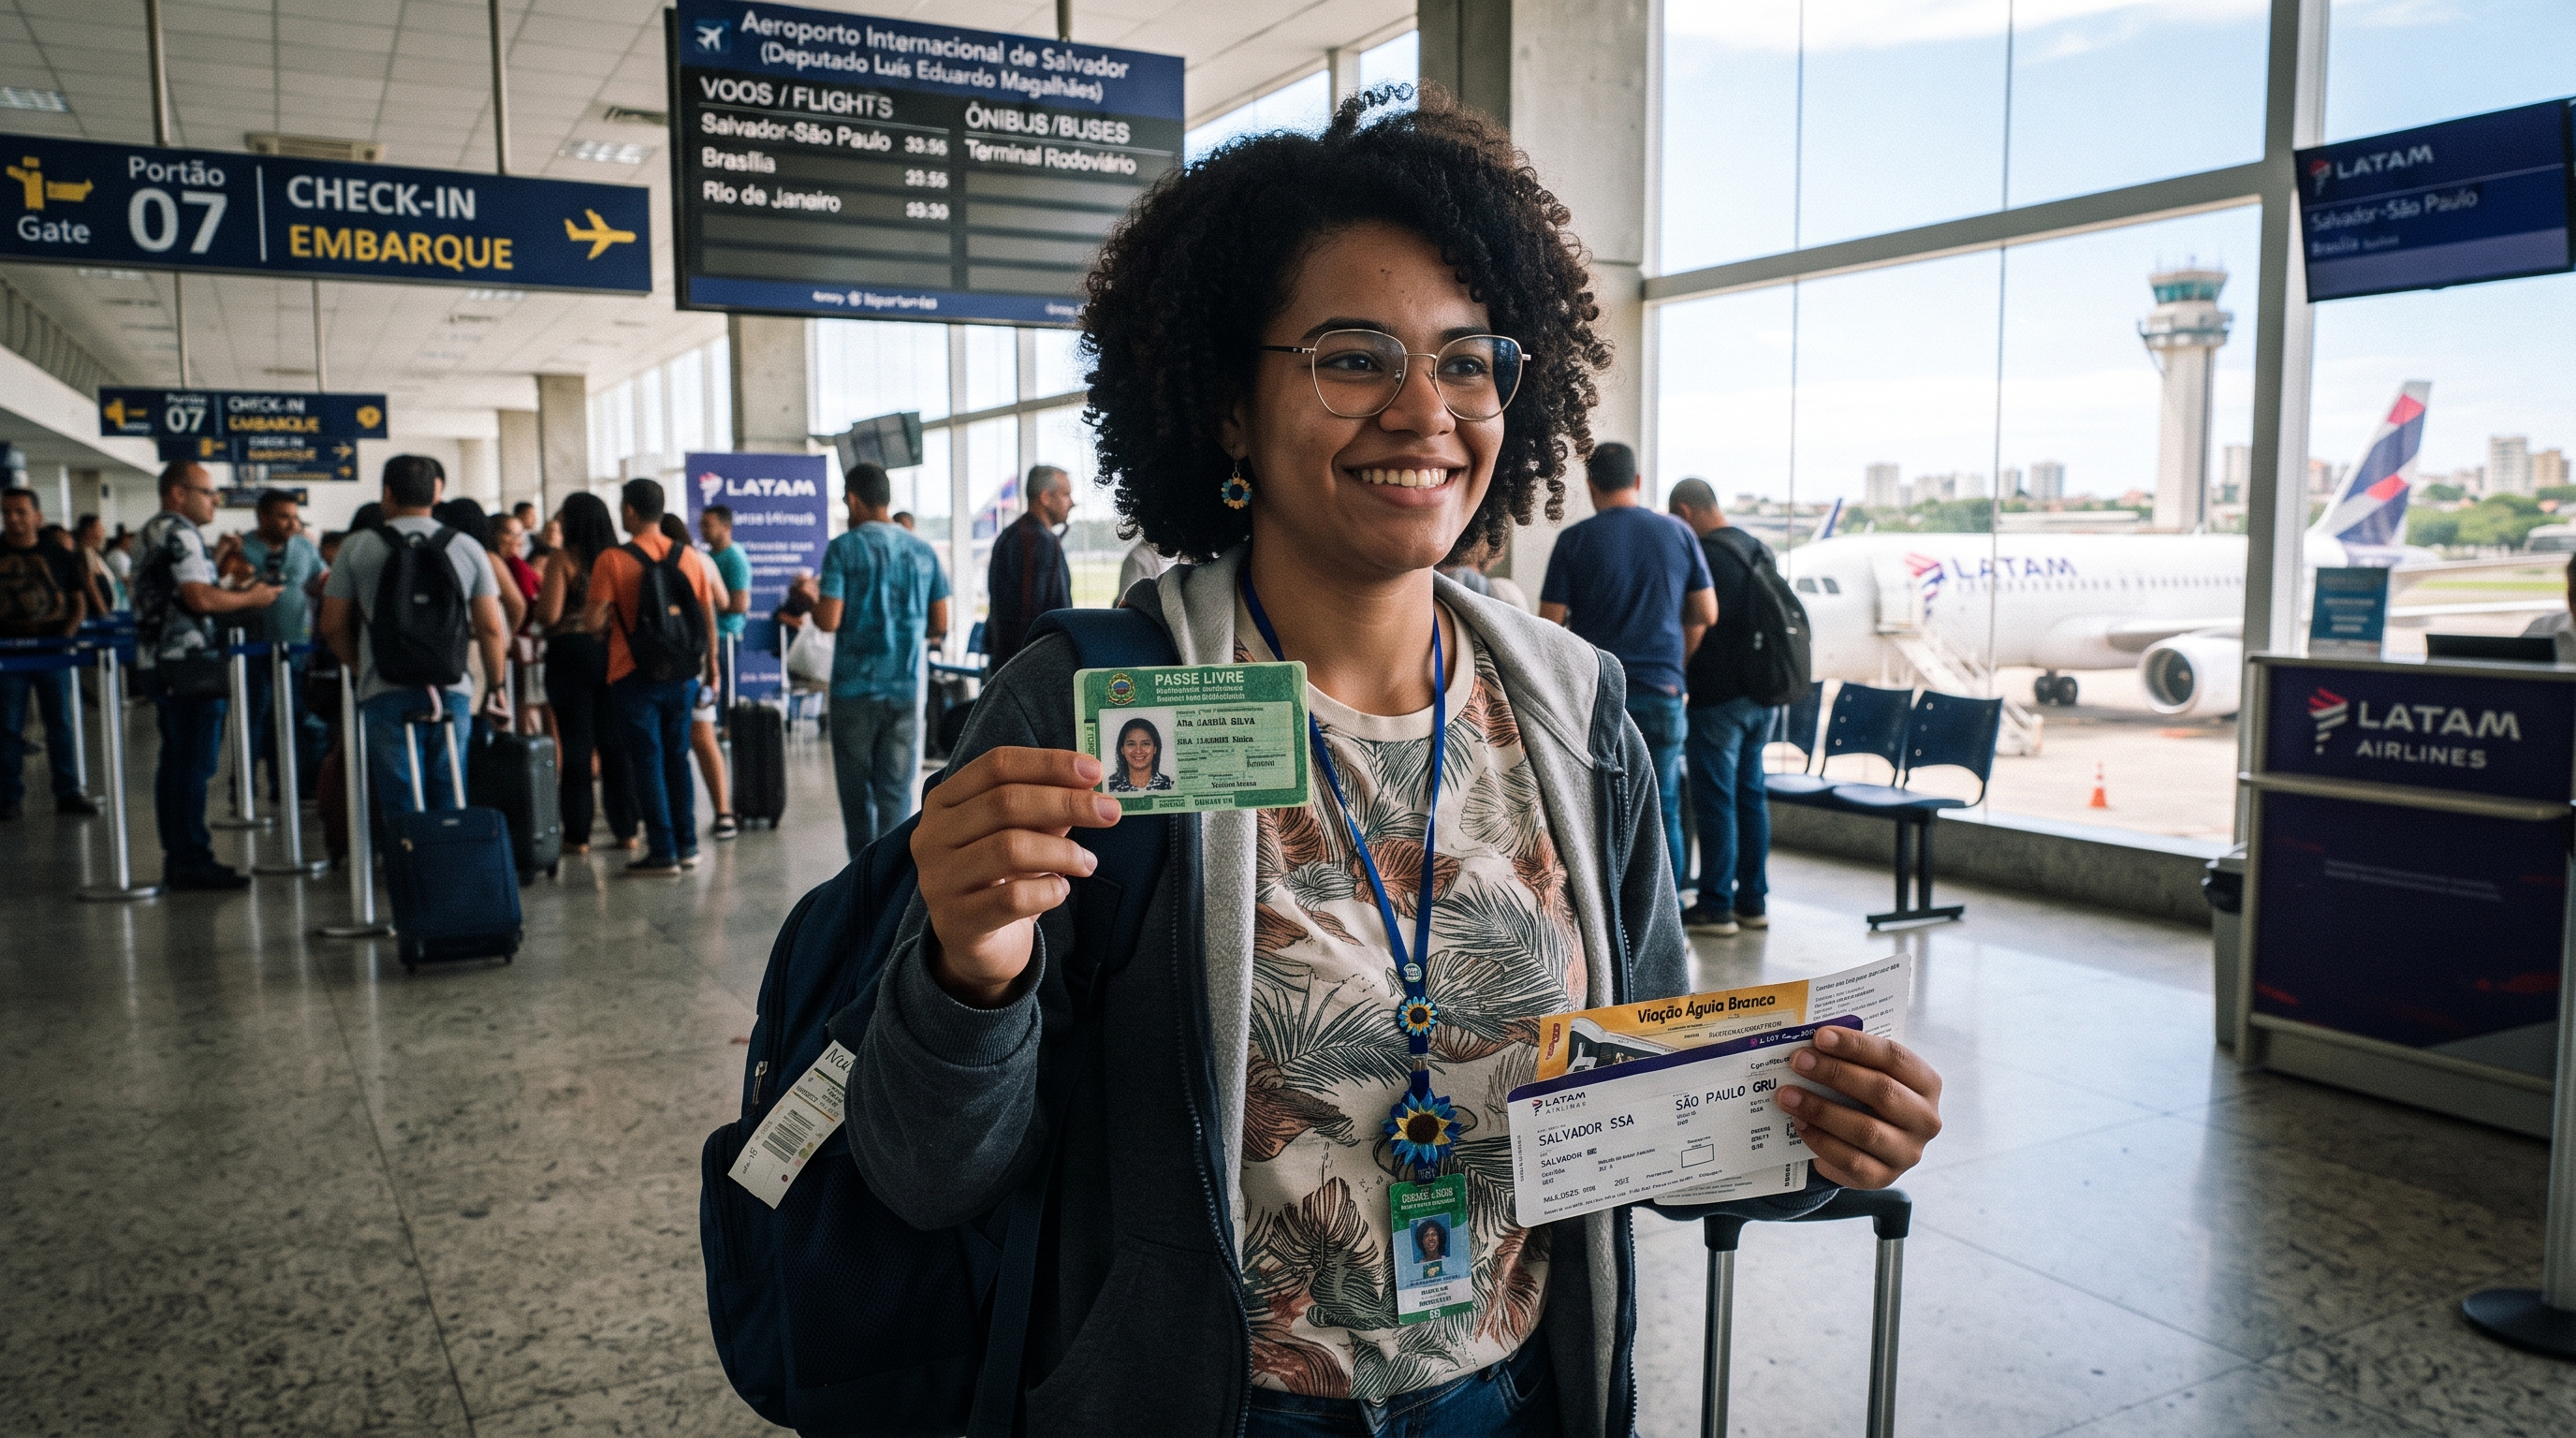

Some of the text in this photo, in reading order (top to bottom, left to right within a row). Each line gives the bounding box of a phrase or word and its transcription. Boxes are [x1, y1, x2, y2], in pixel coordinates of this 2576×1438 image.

[740, 9, 1129, 79] Aeroporto Internacional de Salvador
[760, 41, 1104, 104] (Deputado Luís Eduardo Magalhães)
[700, 76, 894, 119] VOOS / FLIGHTS
[701, 112, 833, 145] Salvador-São
[837, 125, 891, 152] Paulo
[964, 139, 1042, 166] Terminal
[2337, 144, 2434, 180] LATAM
[129, 155, 226, 187] Portão
[286, 175, 476, 220] CHECK-IN
[703, 180, 738, 204] Rio
[740, 183, 767, 206] de
[771, 186, 842, 213] Janeiro
[17, 215, 91, 244] Gate
[128, 188, 228, 254] 07
[289, 225, 513, 271] EMBARQUE
[165, 405, 207, 433] 07
[726, 478, 816, 497] LATAM
[1953, 557, 2077, 580] LATAM
[1155, 671, 1244, 685] PASSE LIVRE
[1231, 717, 1255, 726] SILVA
[2358, 700, 2522, 741] LATAM
[2356, 740, 2487, 770] AIRLINES
[1638, 1005, 1682, 1024] Viação
[1686, 1000, 1724, 1020] Águia
[1545, 1092, 1586, 1107] LATAM
[1676, 1078, 1778, 1110] SÃO PAULO GRU
[1539, 1114, 1634, 1147] SALVADOR SSA
[1541, 1152, 1582, 1167] SALVADOR
